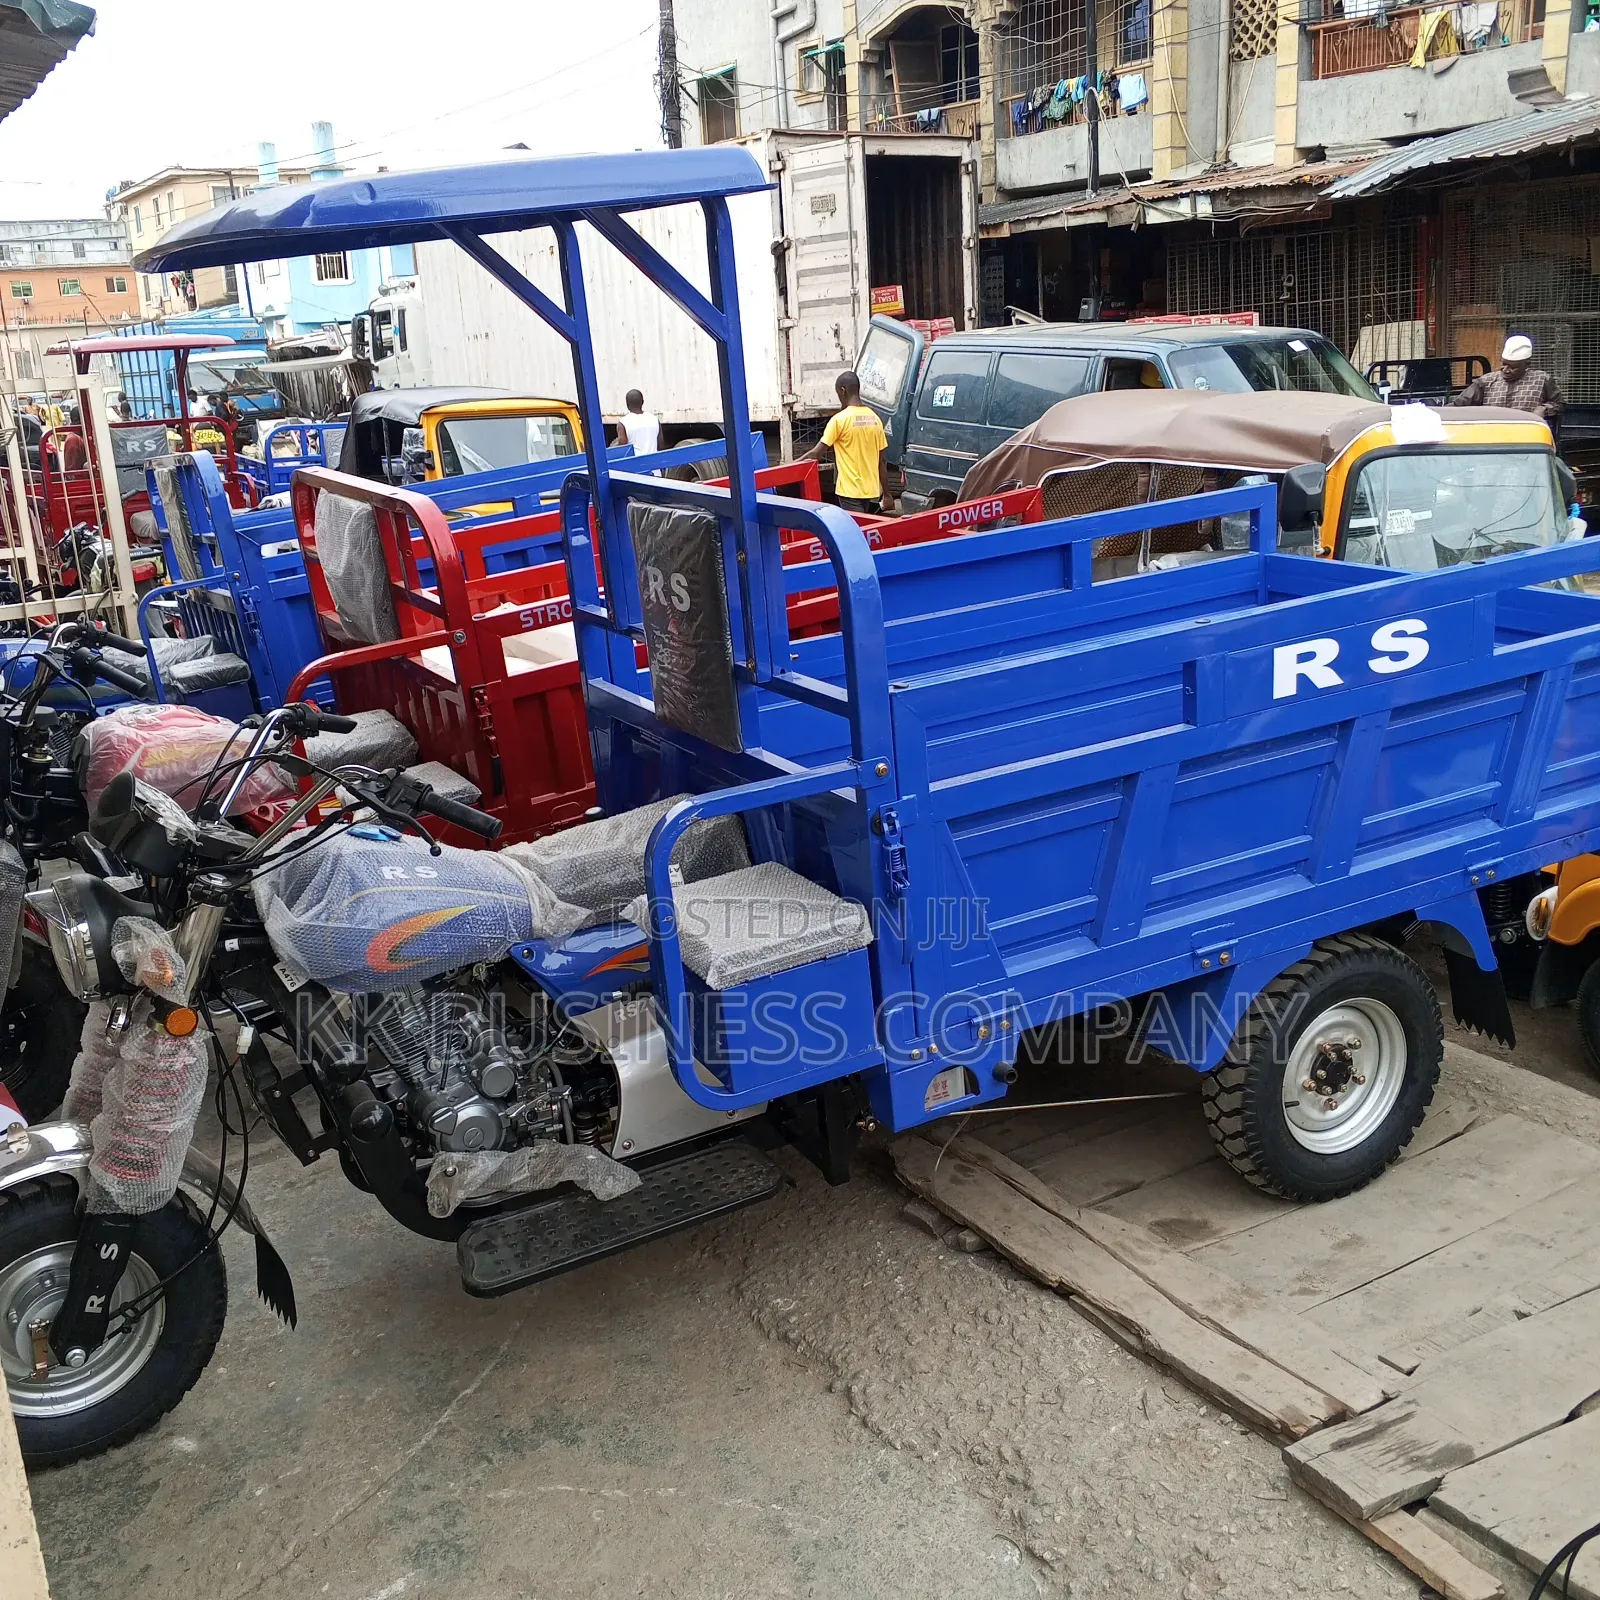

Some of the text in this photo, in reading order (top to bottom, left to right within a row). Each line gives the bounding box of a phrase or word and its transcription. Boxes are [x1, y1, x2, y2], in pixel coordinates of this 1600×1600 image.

[877, 295, 895, 303] TWIST
[938, 499, 1004, 530] POWER
[279, 967, 297, 988] A476
